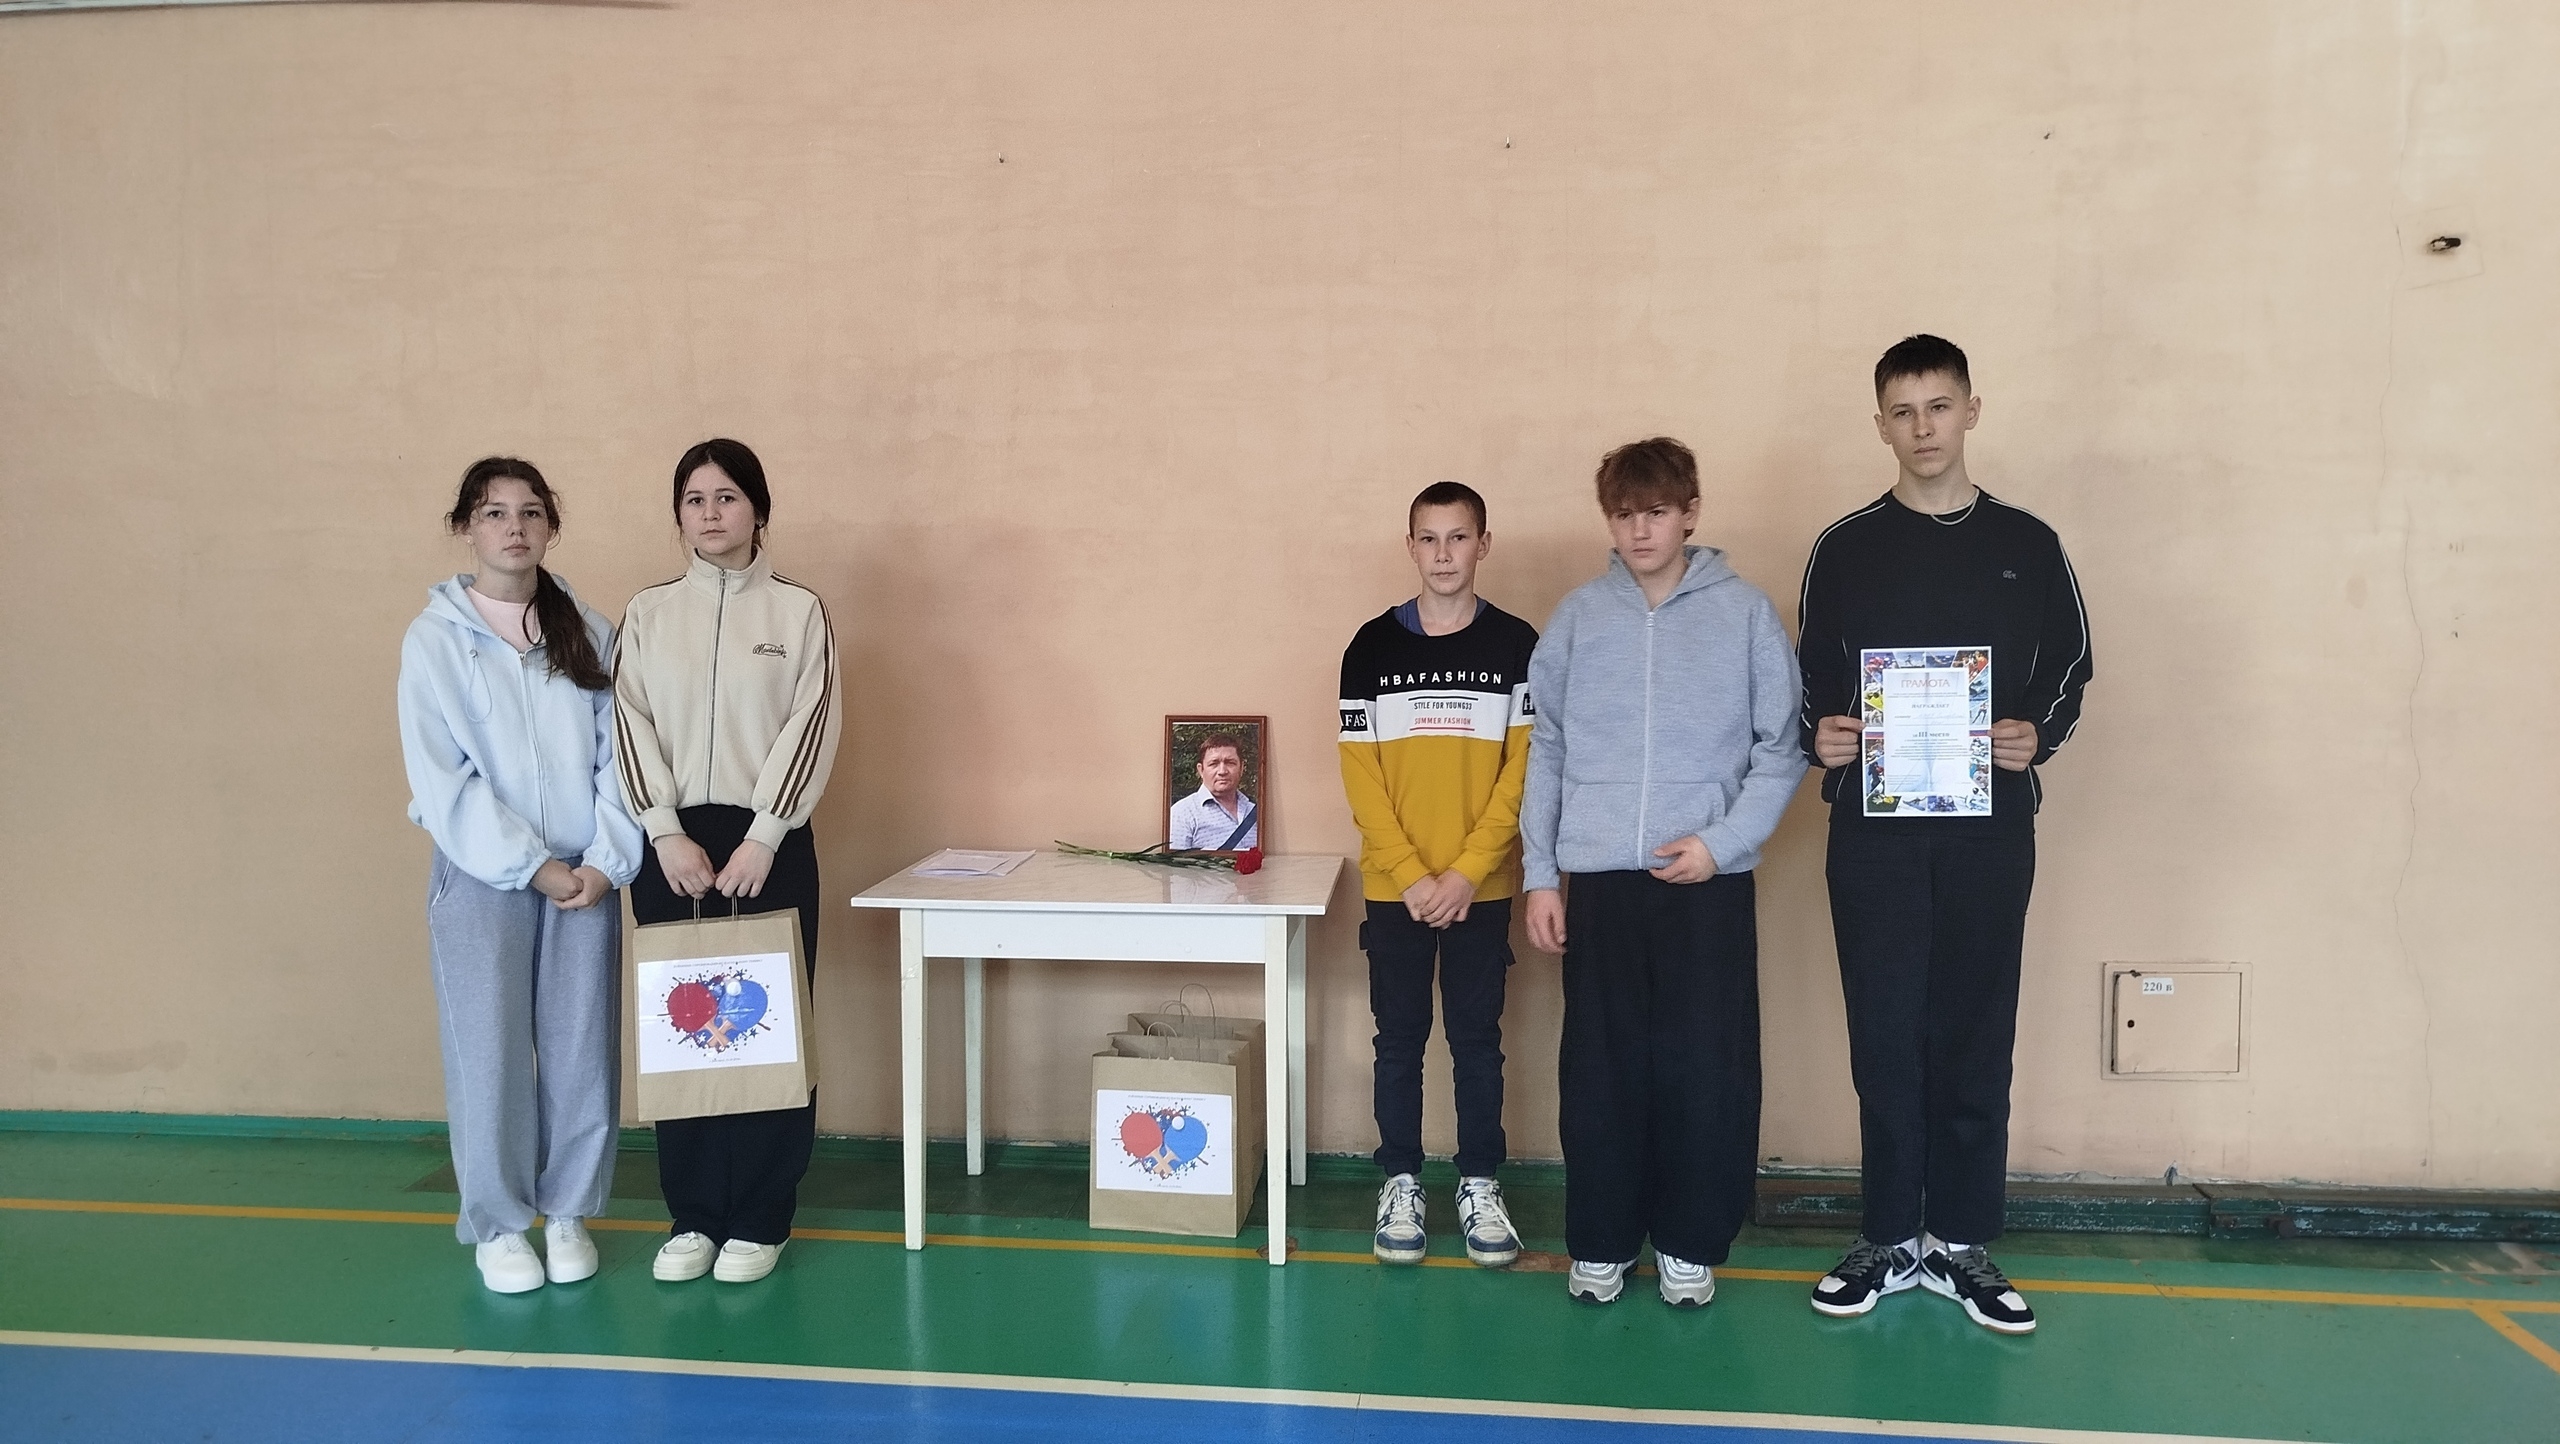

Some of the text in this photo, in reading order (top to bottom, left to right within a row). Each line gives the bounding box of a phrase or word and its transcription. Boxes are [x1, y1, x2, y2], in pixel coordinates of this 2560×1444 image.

[1380, 670, 1502, 687] HBAFASHION
[1901, 679, 1950, 688] ГРАМОТА
[1413, 701, 1430, 710] STYLE
[1432, 701, 1444, 710] FOR
[1414, 717, 1471, 725] SUMMER FASHION
[2143, 982, 2163, 991] 220
